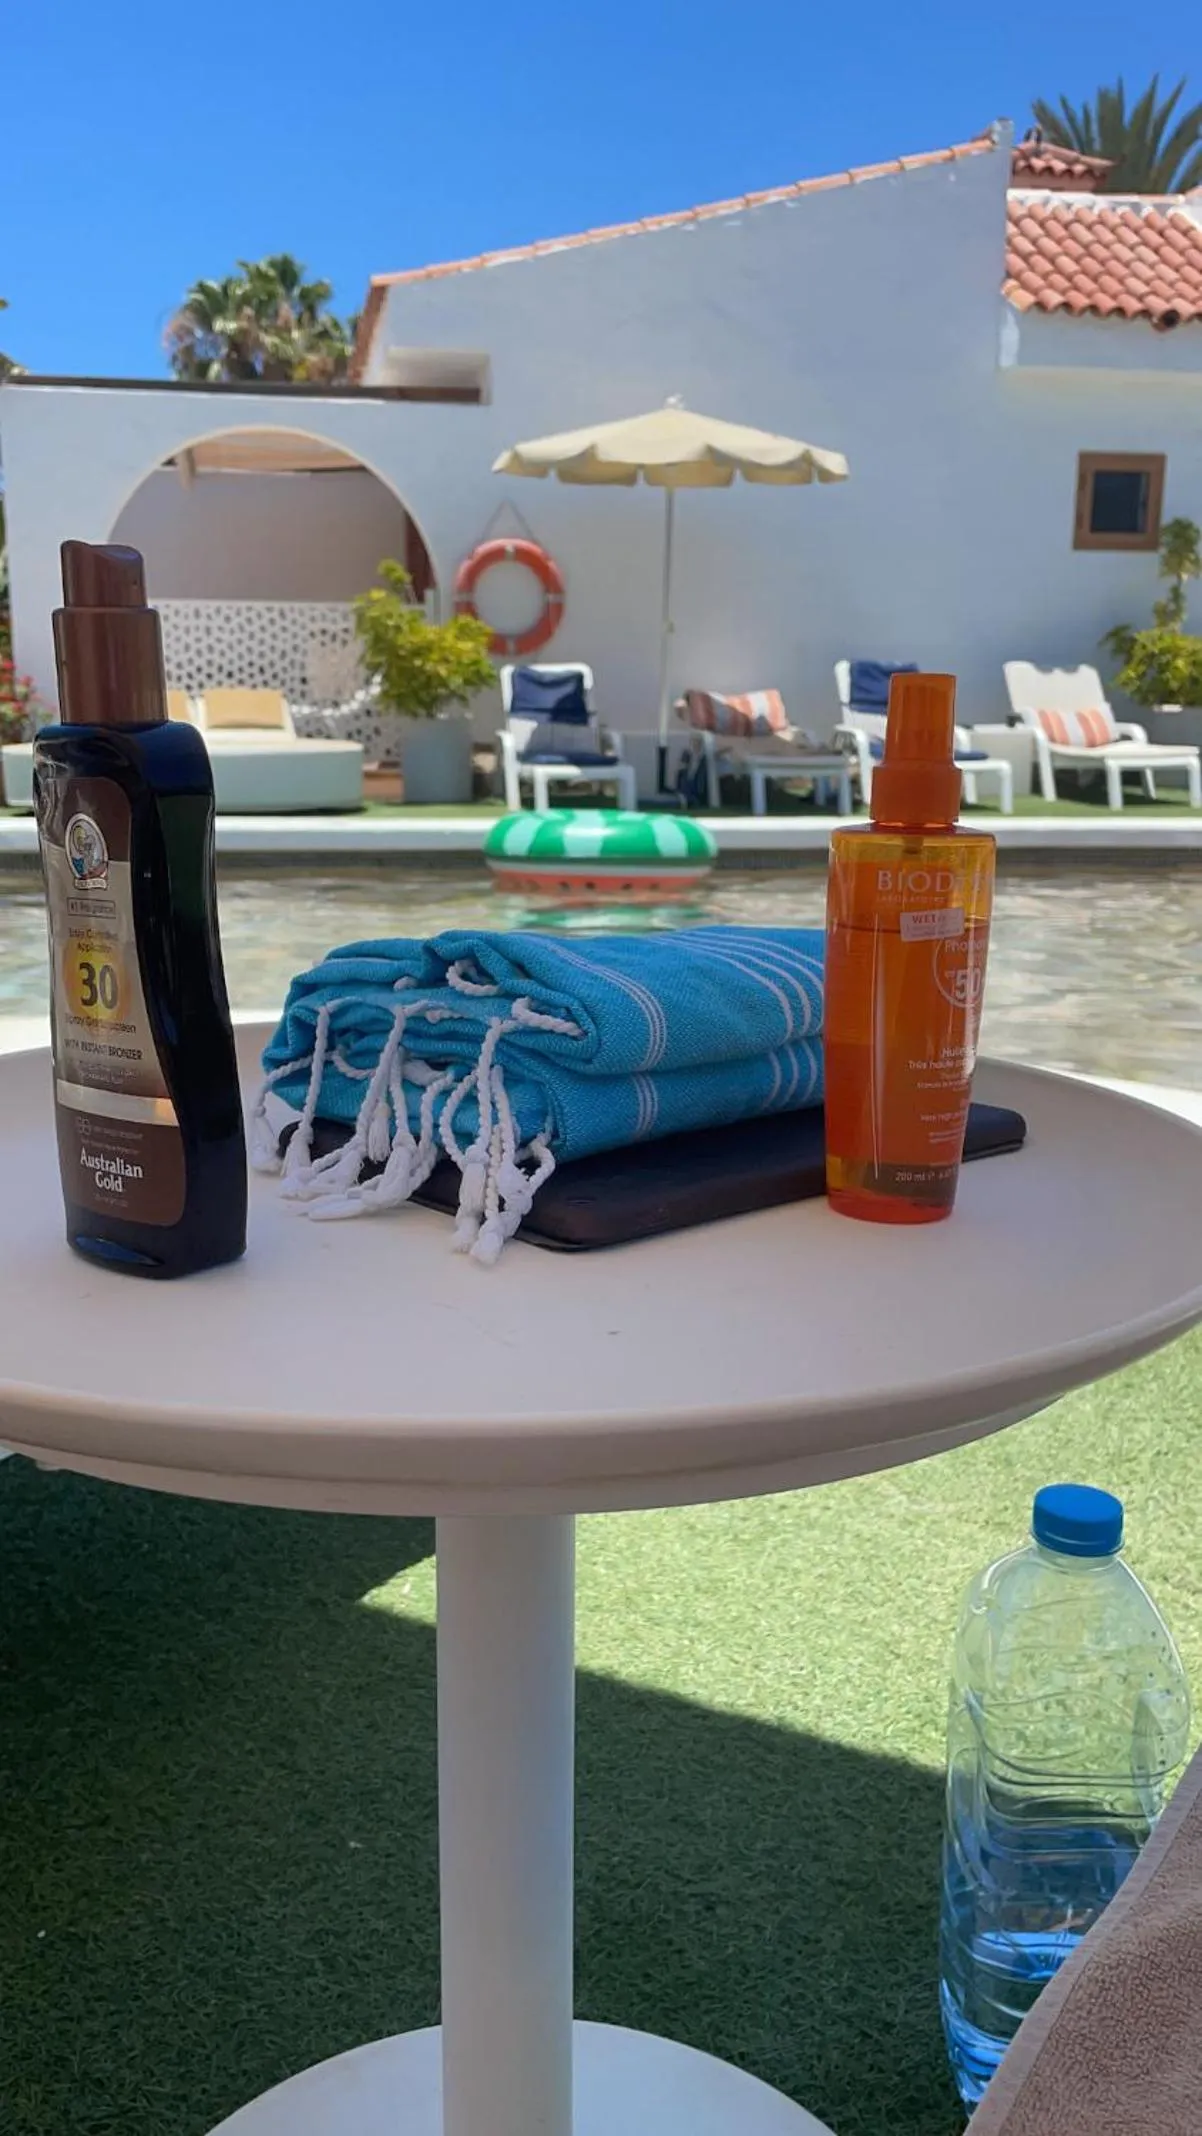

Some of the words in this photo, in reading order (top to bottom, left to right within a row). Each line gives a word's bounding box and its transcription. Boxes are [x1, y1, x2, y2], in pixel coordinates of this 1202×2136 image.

[79, 962, 119, 1009] 30
[108, 1046, 143, 1060] BRONZER
[80, 1146, 143, 1178] Australian
[95, 1171, 123, 1192] Gold
[895, 1171, 913, 1181] 200
